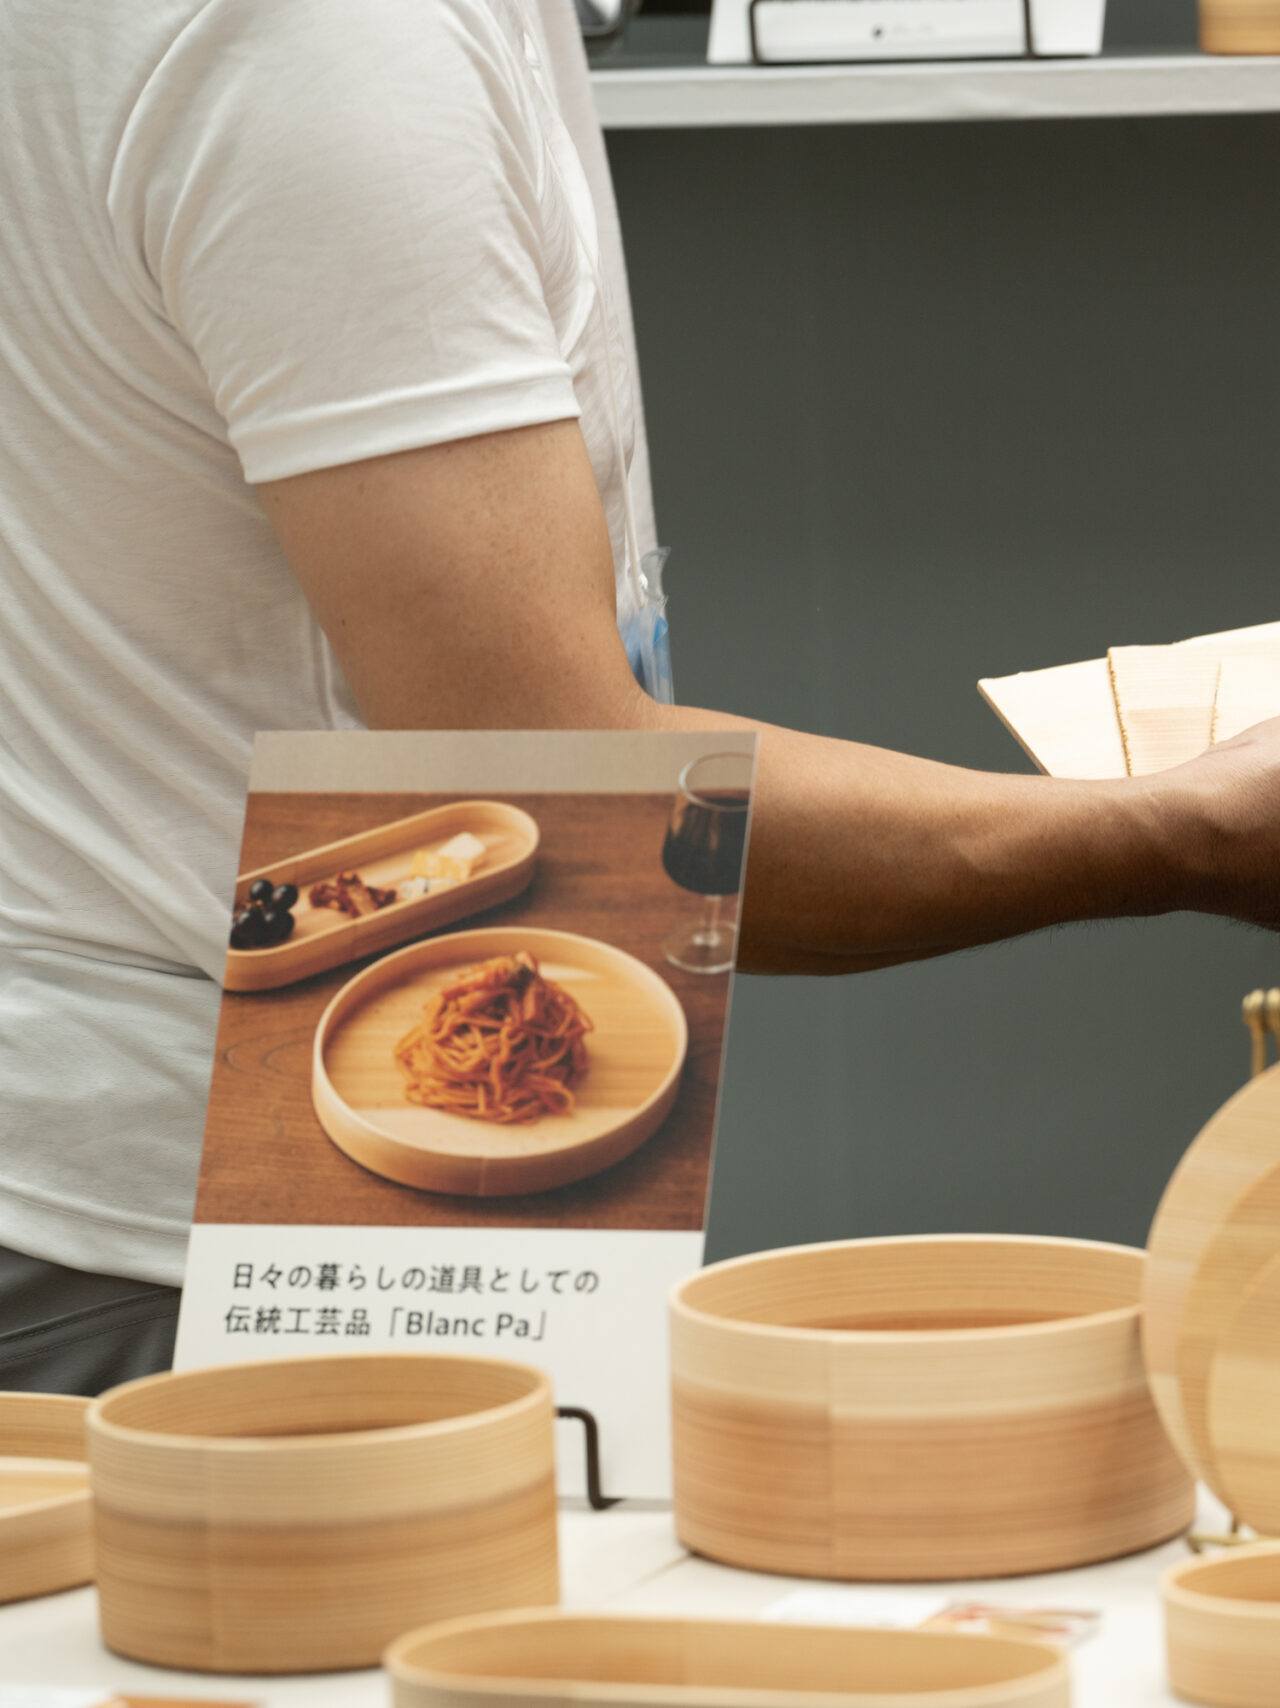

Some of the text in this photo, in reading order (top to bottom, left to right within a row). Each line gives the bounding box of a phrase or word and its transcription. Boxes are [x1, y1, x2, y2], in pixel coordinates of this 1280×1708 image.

[231, 1262, 599, 1295] 日々の暮らしの道具としての
